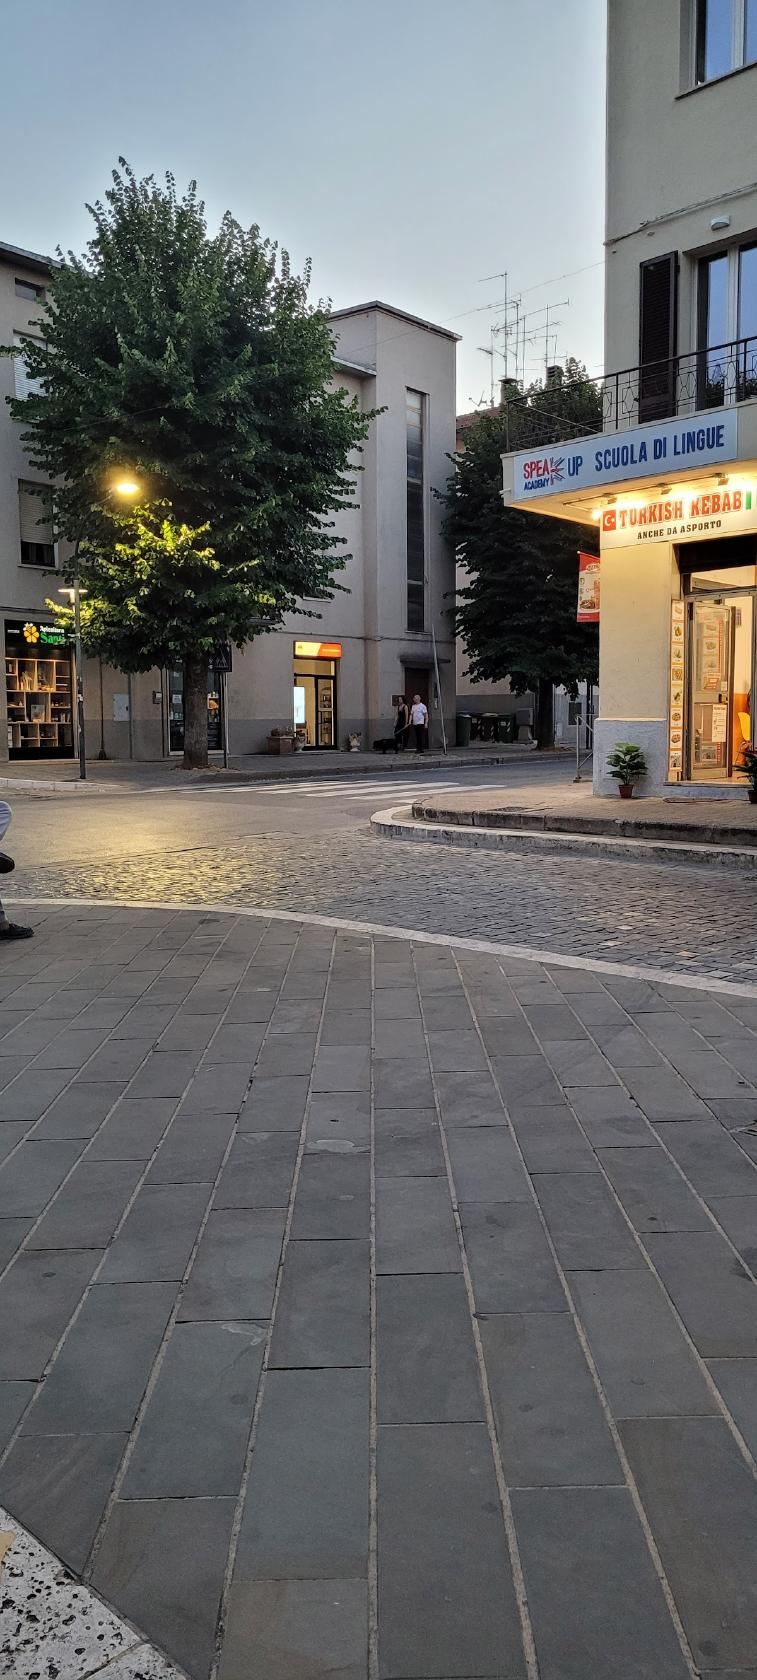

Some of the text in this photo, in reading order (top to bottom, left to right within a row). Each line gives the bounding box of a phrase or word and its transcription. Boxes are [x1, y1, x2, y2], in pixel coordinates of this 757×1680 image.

[595, 425, 725, 472] SCUOLA DI LINGUE
[567, 456, 583, 477] UP
[523, 478, 550, 491] ACADEMY
[618, 490, 742, 529] TURKISH KEBAB
[637, 520, 722, 540] ANCHE DA ASPORTO
